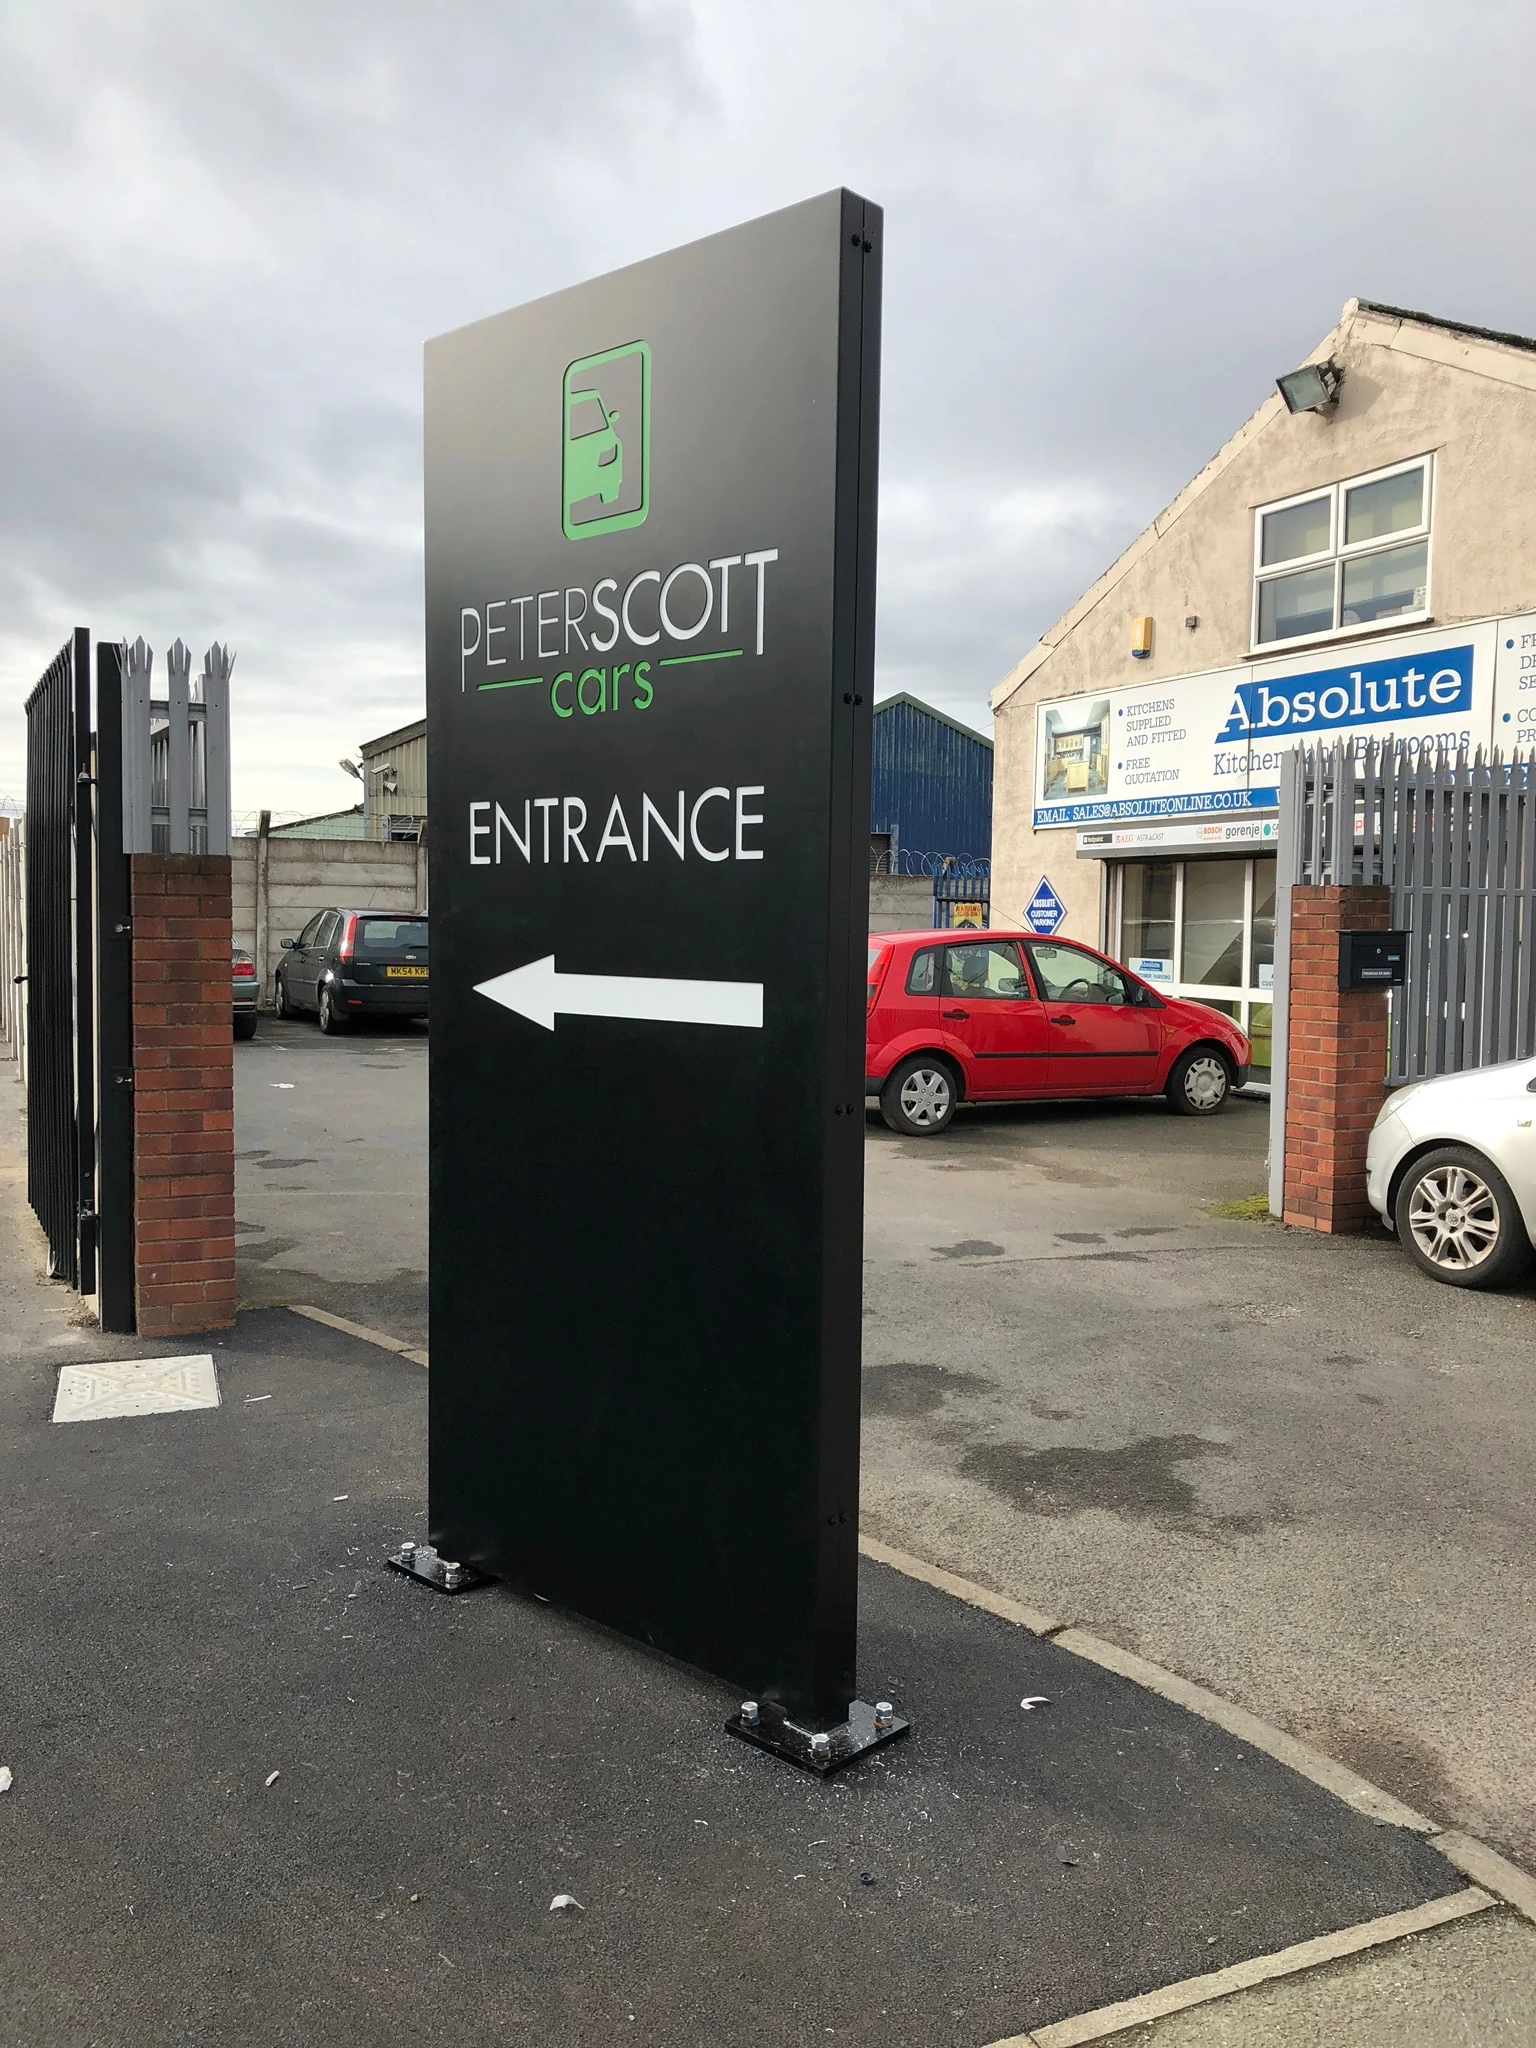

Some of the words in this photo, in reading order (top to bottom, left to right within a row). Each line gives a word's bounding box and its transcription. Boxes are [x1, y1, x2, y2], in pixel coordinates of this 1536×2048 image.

[461, 547, 778, 692] PETERSCOTT
[550, 660, 654, 718] cars
[1126, 698, 1175, 717] KITCHENS
[1217, 667, 1462, 734] Absolute
[1126, 715, 1172, 732] SUPPLIED
[1126, 734, 1149, 748] AND
[1151, 728, 1187, 744] FITTED
[1125, 757, 1151, 771] FREE
[1213, 749, 1282, 776] Kitchen
[1124, 769, 1180, 786] QUOTATION
[1036, 807, 1070, 824] EMAIL:
[1072, 791, 1253, 820] SALES@ABSOLUTEONLINE.CO.UK
[469, 785, 765, 865] ENTRANCE
[1203, 826, 1223, 835] BOSCH
[1225, 823, 1260, 840] gorenje
[1032, 898, 1056, 908] ABSOLUTE
[1030, 910, 1058, 918] CUSTOMER
[1032, 918, 1055, 927] PARKING
[390, 967, 413, 976] MK54
